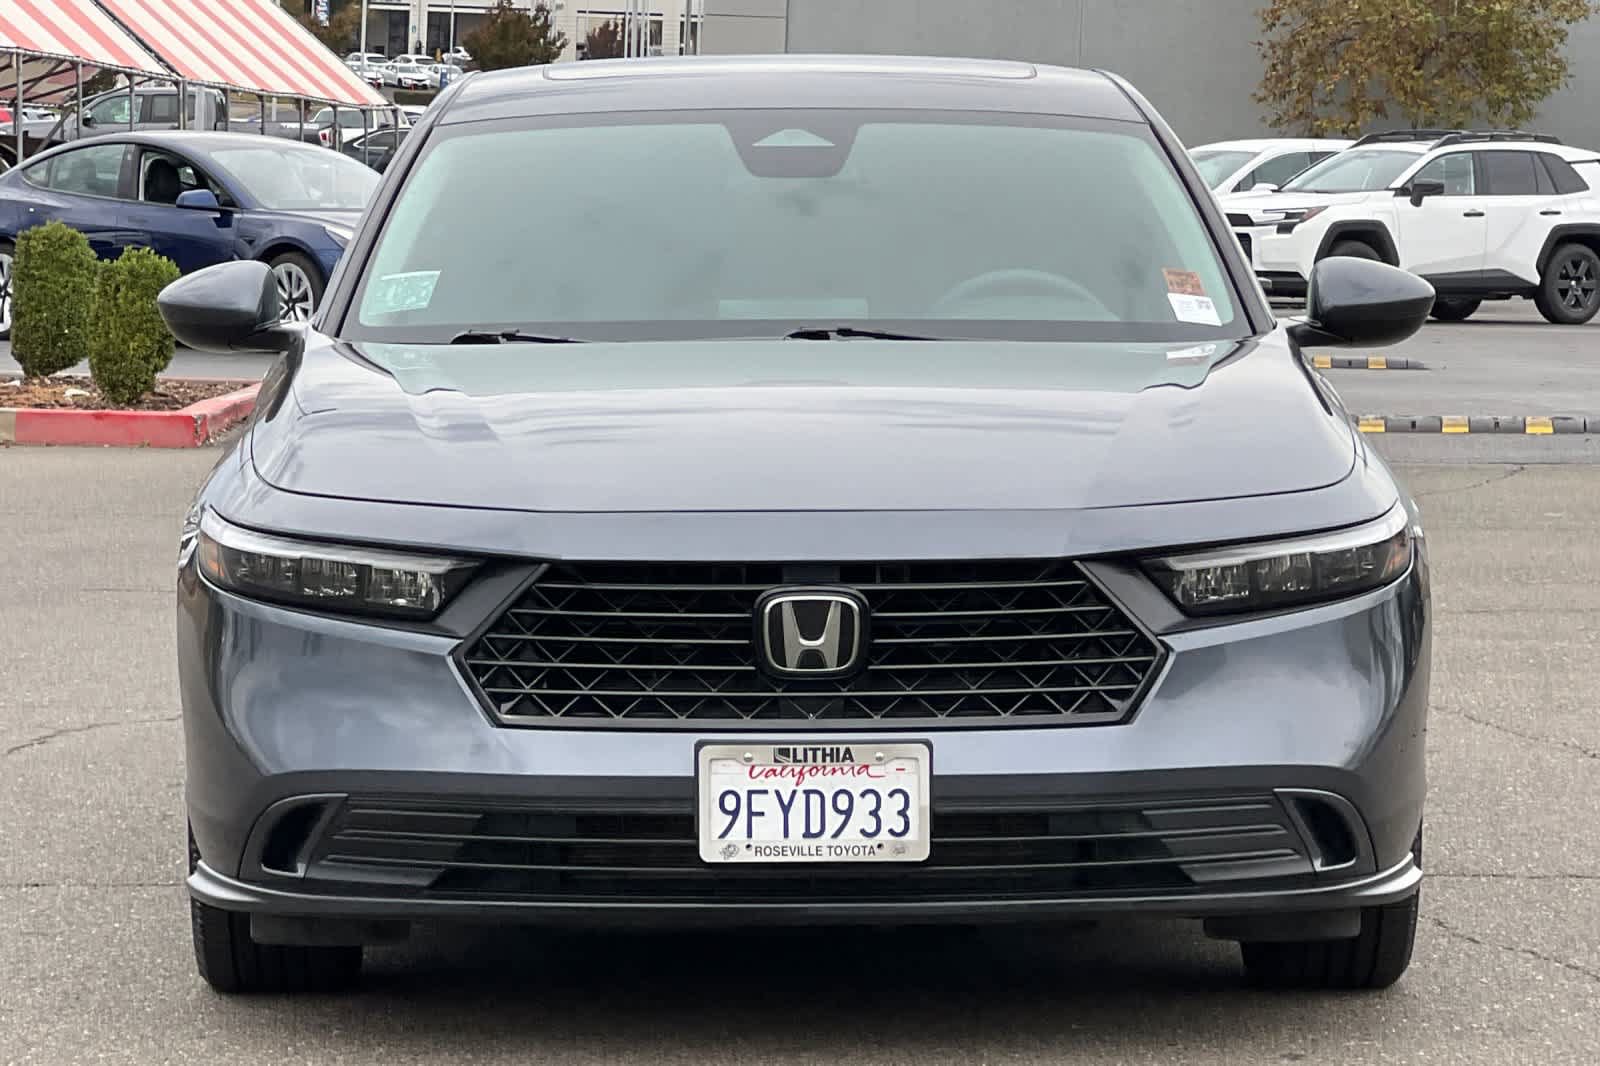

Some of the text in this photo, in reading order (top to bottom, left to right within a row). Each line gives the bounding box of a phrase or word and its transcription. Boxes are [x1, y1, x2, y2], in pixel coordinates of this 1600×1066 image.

[791, 747, 855, 763] LITHIA
[718, 788, 911, 839] 9FYD933
[754, 845, 876, 857] ROSEVILLE TOYOTA
